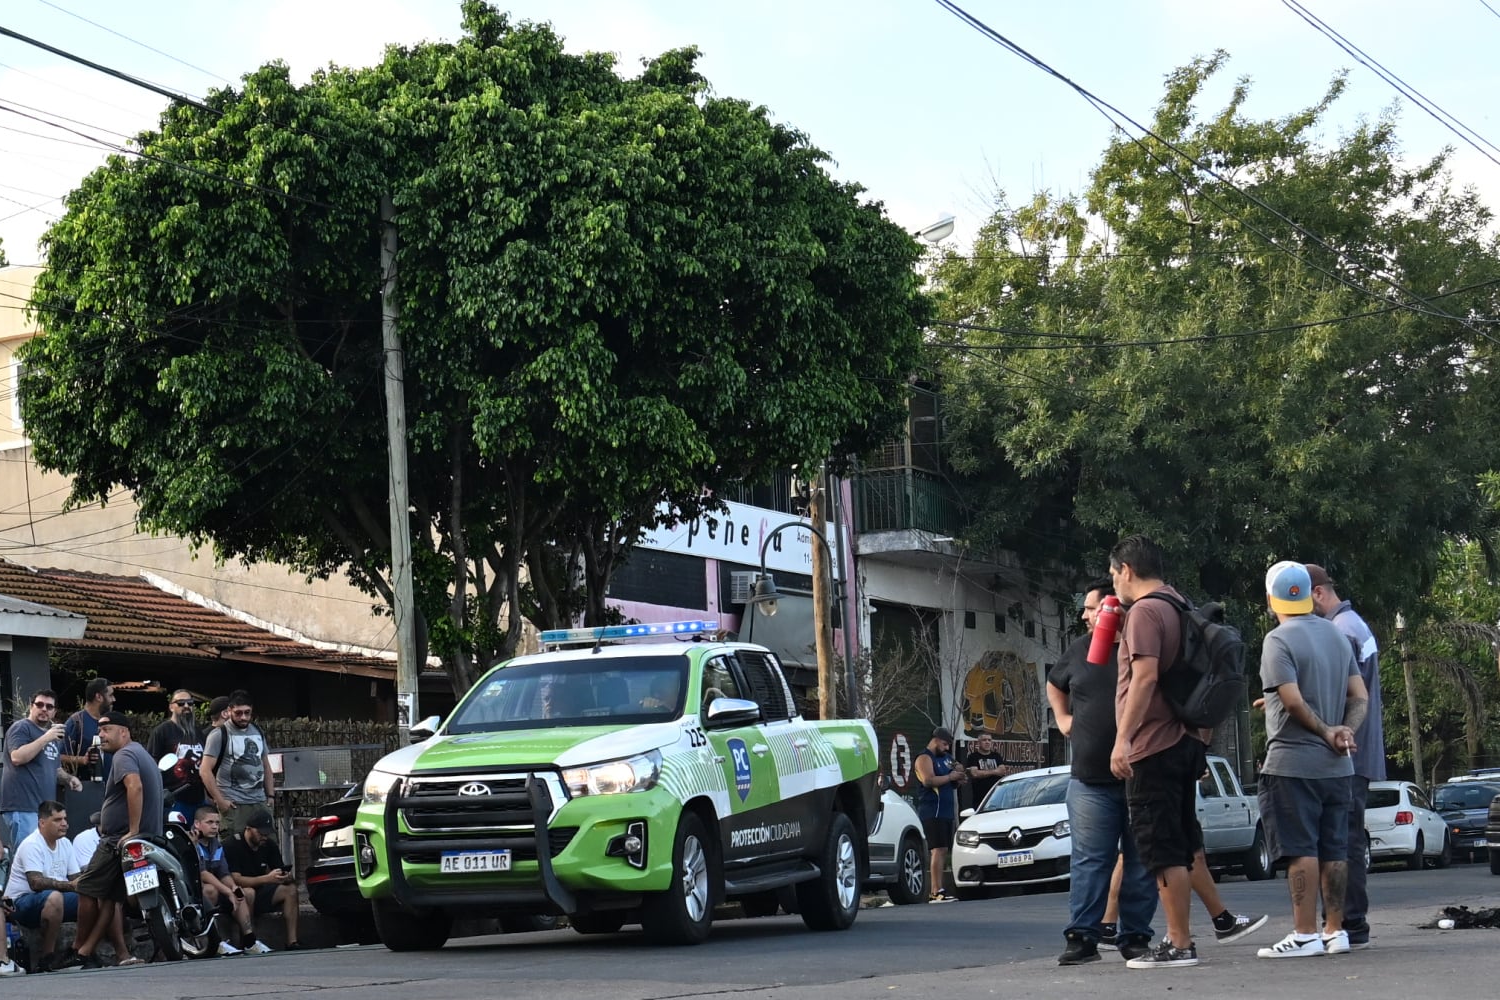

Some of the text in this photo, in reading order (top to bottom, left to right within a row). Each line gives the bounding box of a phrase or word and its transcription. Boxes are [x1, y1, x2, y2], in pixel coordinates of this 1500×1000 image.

[685, 727, 706, 747] 225
[732, 747, 749, 771] PC
[730, 821, 770, 848] PROTECCIÓN
[444, 855, 507, 871] AE 011 UR
